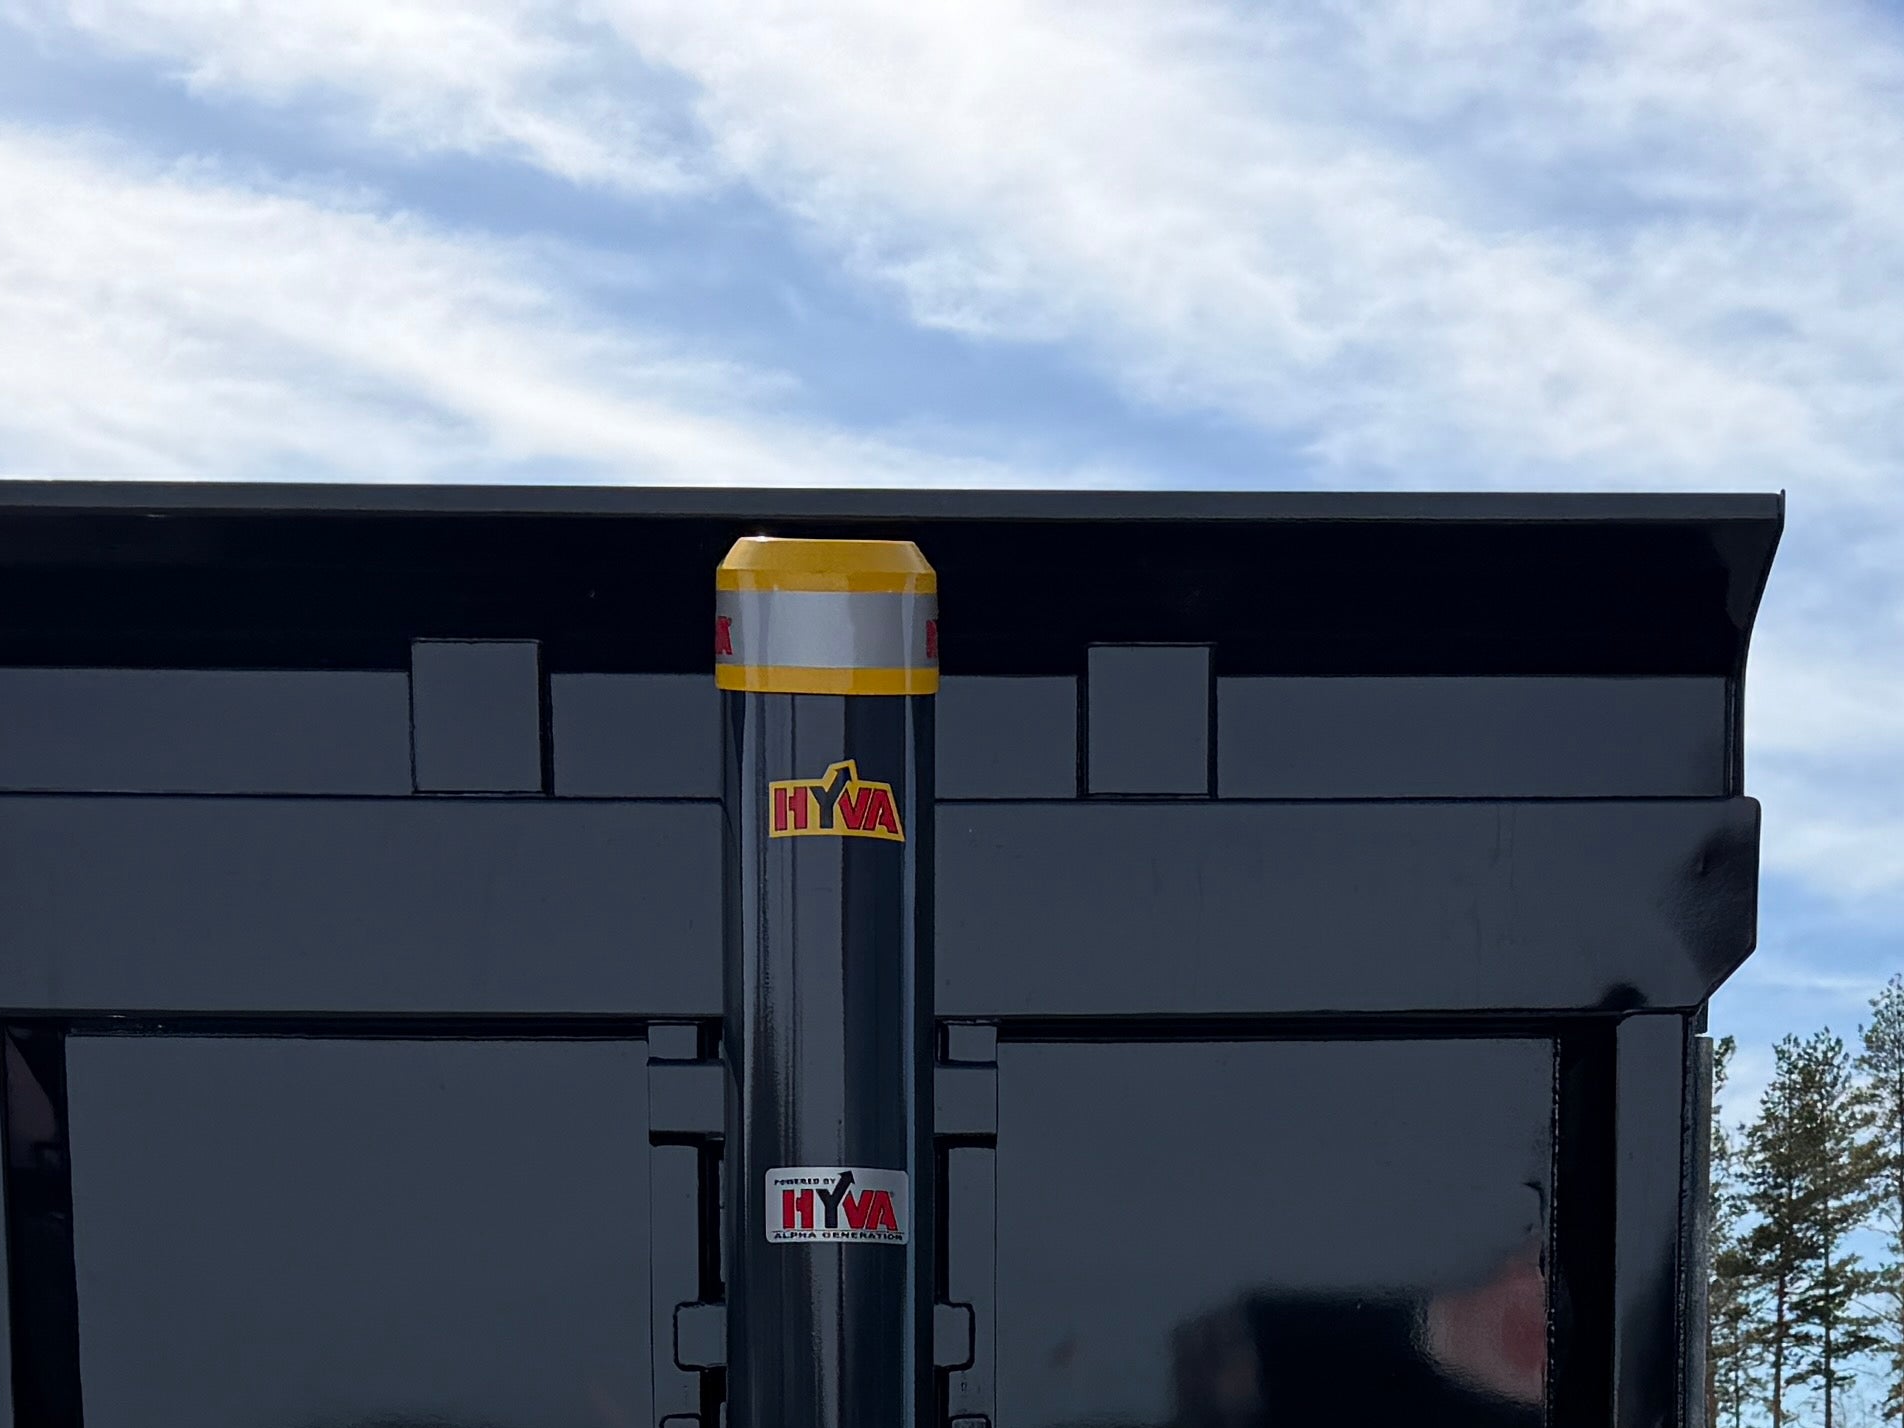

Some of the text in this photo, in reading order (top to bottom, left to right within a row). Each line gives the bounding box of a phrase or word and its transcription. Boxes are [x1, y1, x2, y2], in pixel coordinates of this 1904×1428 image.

[774, 767, 899, 834] HYVA
[782, 1171, 899, 1231] HYVA
[774, 1231, 903, 1241] ALPHA GENERATION
